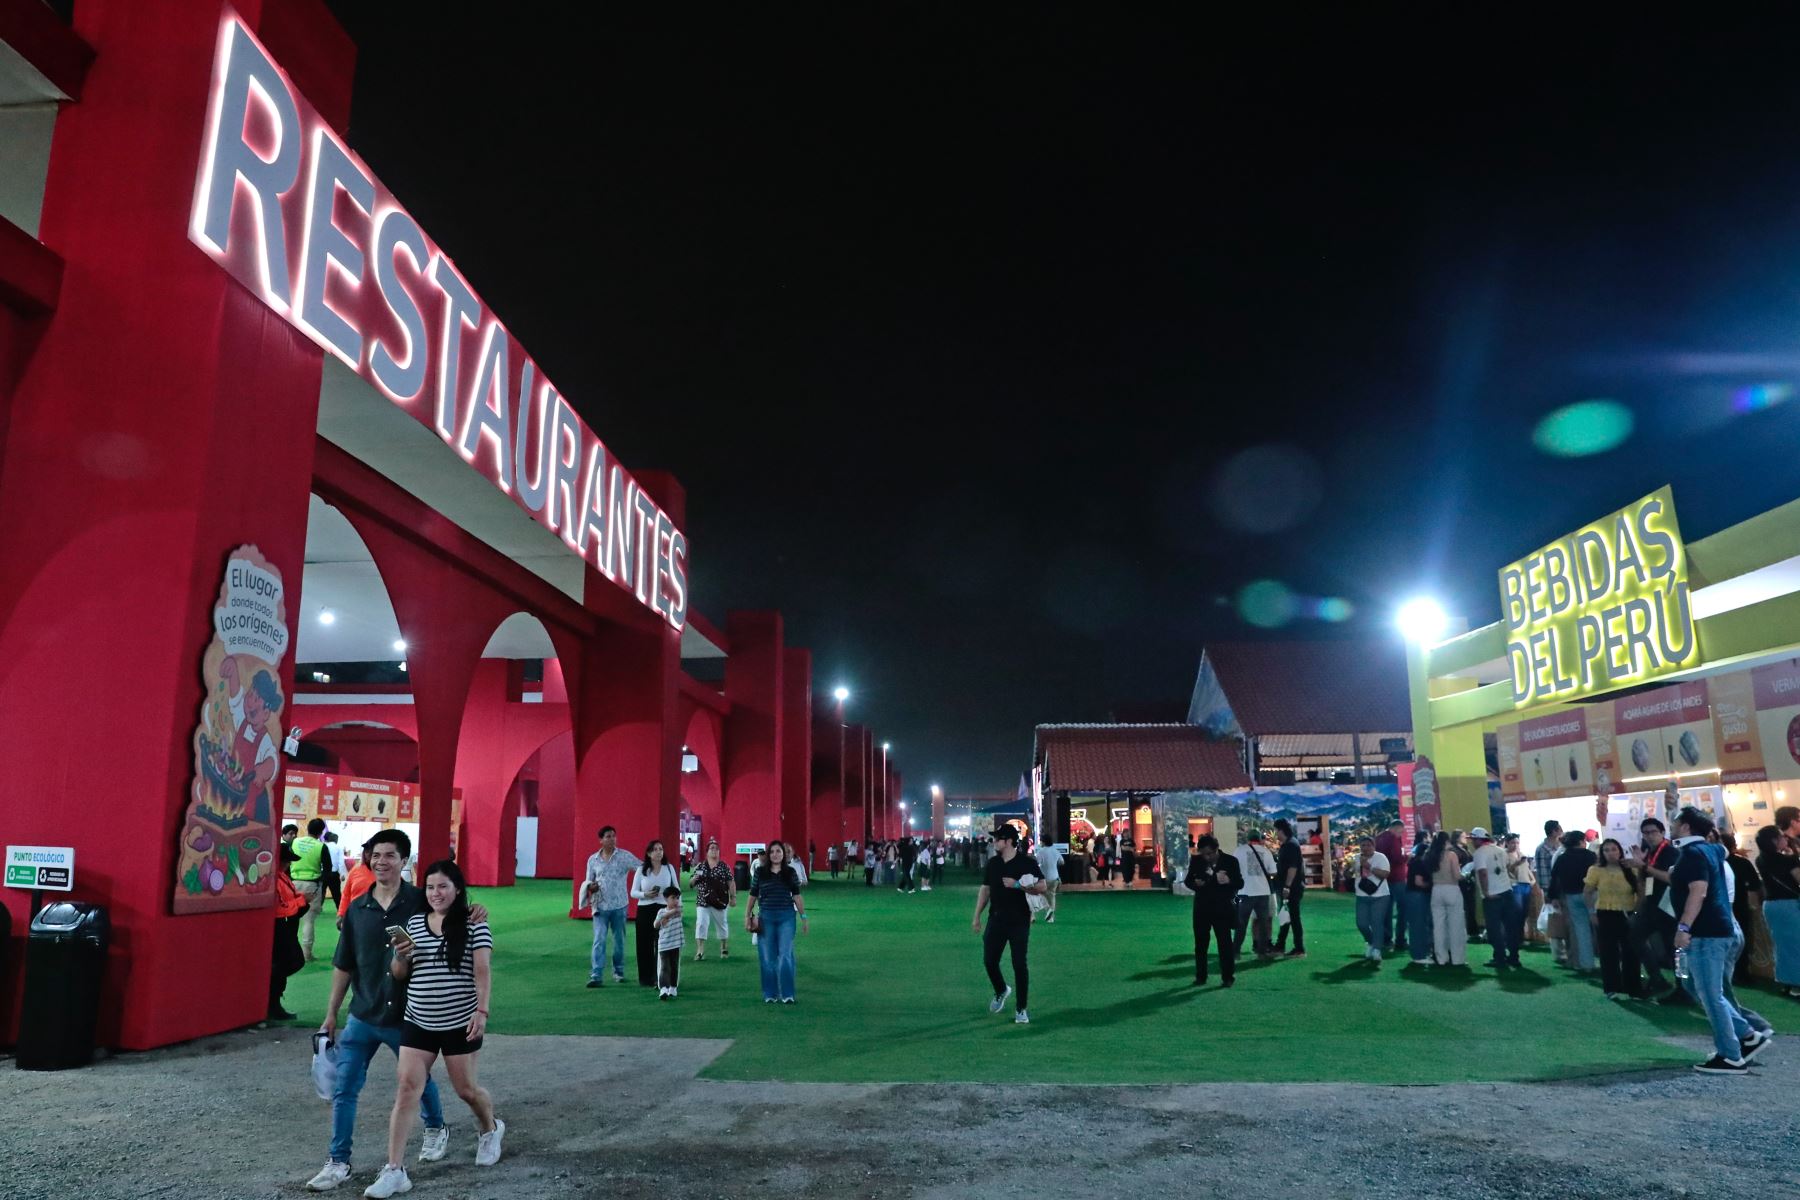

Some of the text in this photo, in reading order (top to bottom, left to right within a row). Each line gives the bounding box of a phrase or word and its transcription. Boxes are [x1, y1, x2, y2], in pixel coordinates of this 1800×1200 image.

[202, 18, 686, 628] RESTAURANTES
[1503, 500, 1675, 631] BEBIDAS
[231, 568, 279, 601] El lugar
[231, 597, 273, 619] donde todos
[220, 613, 285, 646] los orígenes
[229, 635, 275, 656] se encuentran
[1507, 570, 1694, 704] DEL PERÚ
[14, 852, 32, 861] PUNTO
